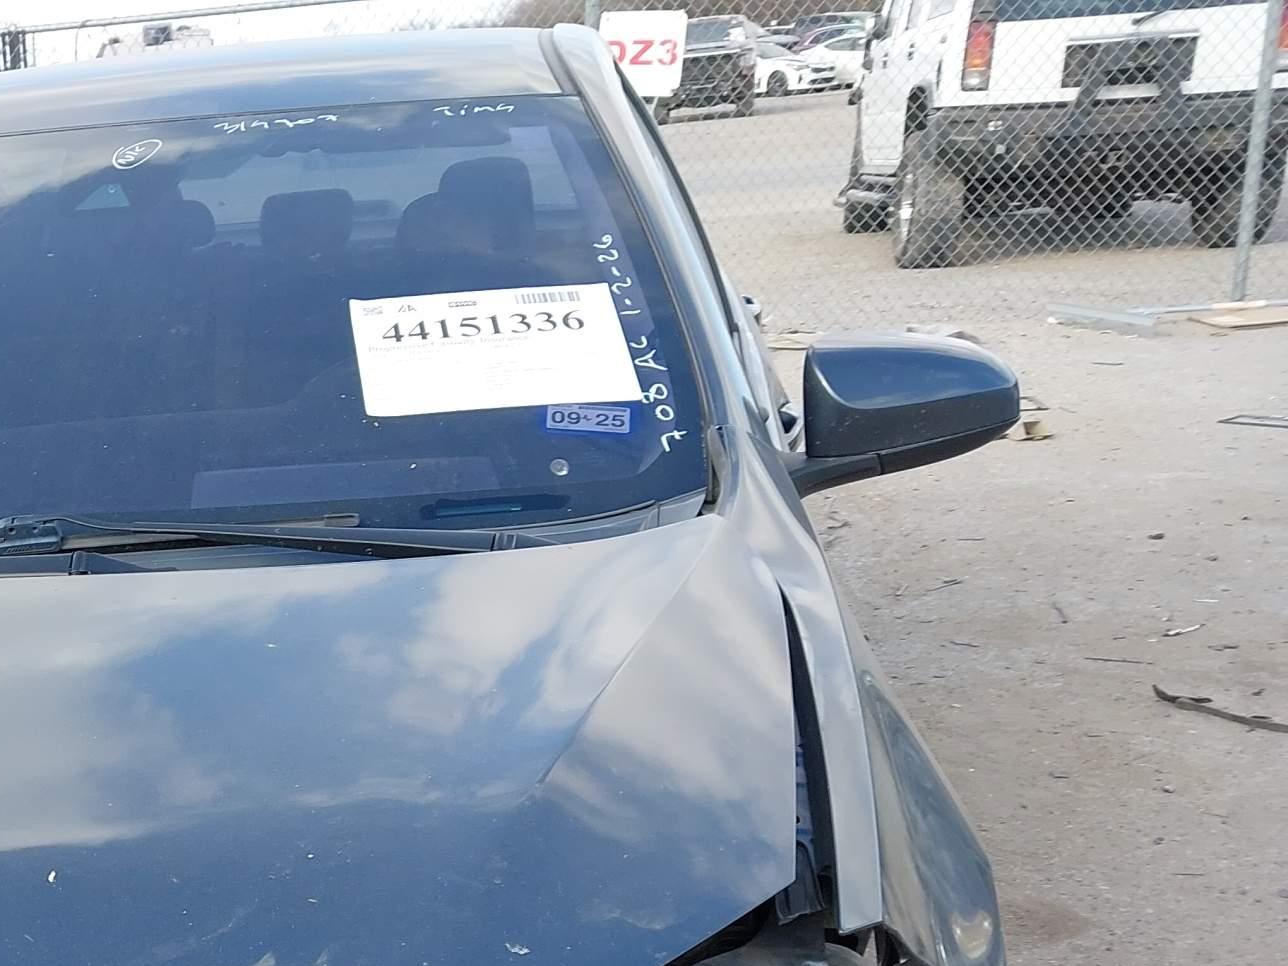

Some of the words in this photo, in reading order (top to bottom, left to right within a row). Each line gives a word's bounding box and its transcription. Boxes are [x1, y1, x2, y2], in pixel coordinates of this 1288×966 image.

[381, 309, 585, 343] 44151336
[551, 410, 581, 425] 09
[594, 413, 626, 428] 25
